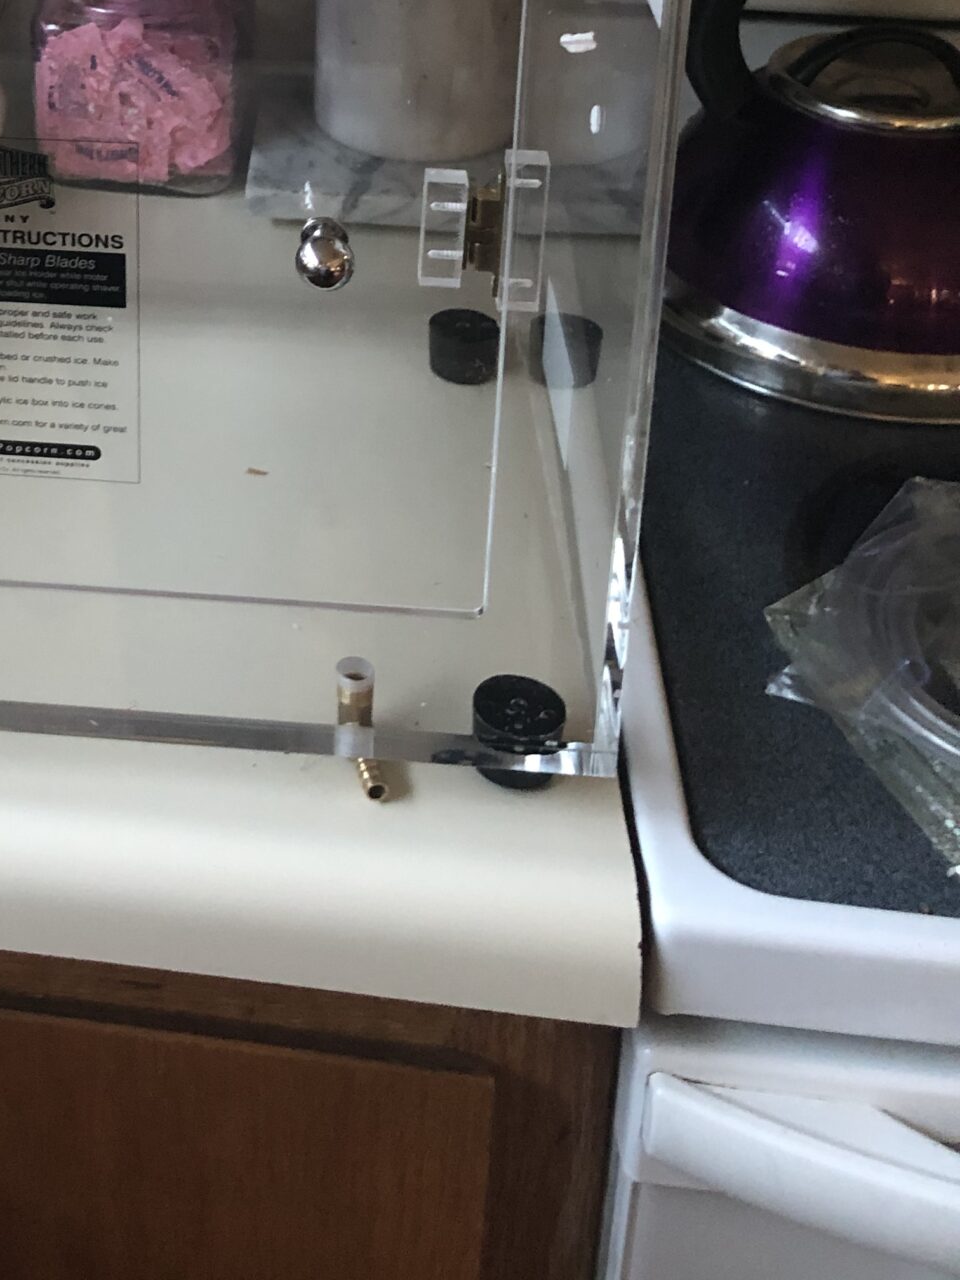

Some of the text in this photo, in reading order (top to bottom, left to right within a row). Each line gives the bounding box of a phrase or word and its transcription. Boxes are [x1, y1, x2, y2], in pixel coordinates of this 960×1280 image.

[45, 254, 96, 270] Blades
[83, 273, 109, 281] motor
[50, 282, 89, 291] operating
[31, 310, 49, 318] and
[52, 311, 72, 319] safe
[50, 322, 83, 331] Always
[85, 324, 114, 332] check
[28, 332, 59, 340] before
[60, 334, 84, 343] each
[33, 354, 71, 364] crushed
[92, 357, 120, 367] Make
[8, 374, 19, 383] lid
[21, 375, 54, 385] handle
[56, 378, 65, 386] to
[67, 378, 91, 388] push
[93, 380, 109, 388] ice
[31, 398, 49, 407] box
[51, 400, 69, 408] into
[72, 400, 85, 409] ice
[58, 422, 90, 432] variety
[91, 423, 101, 431] of
[103, 425, 127, 434] great
